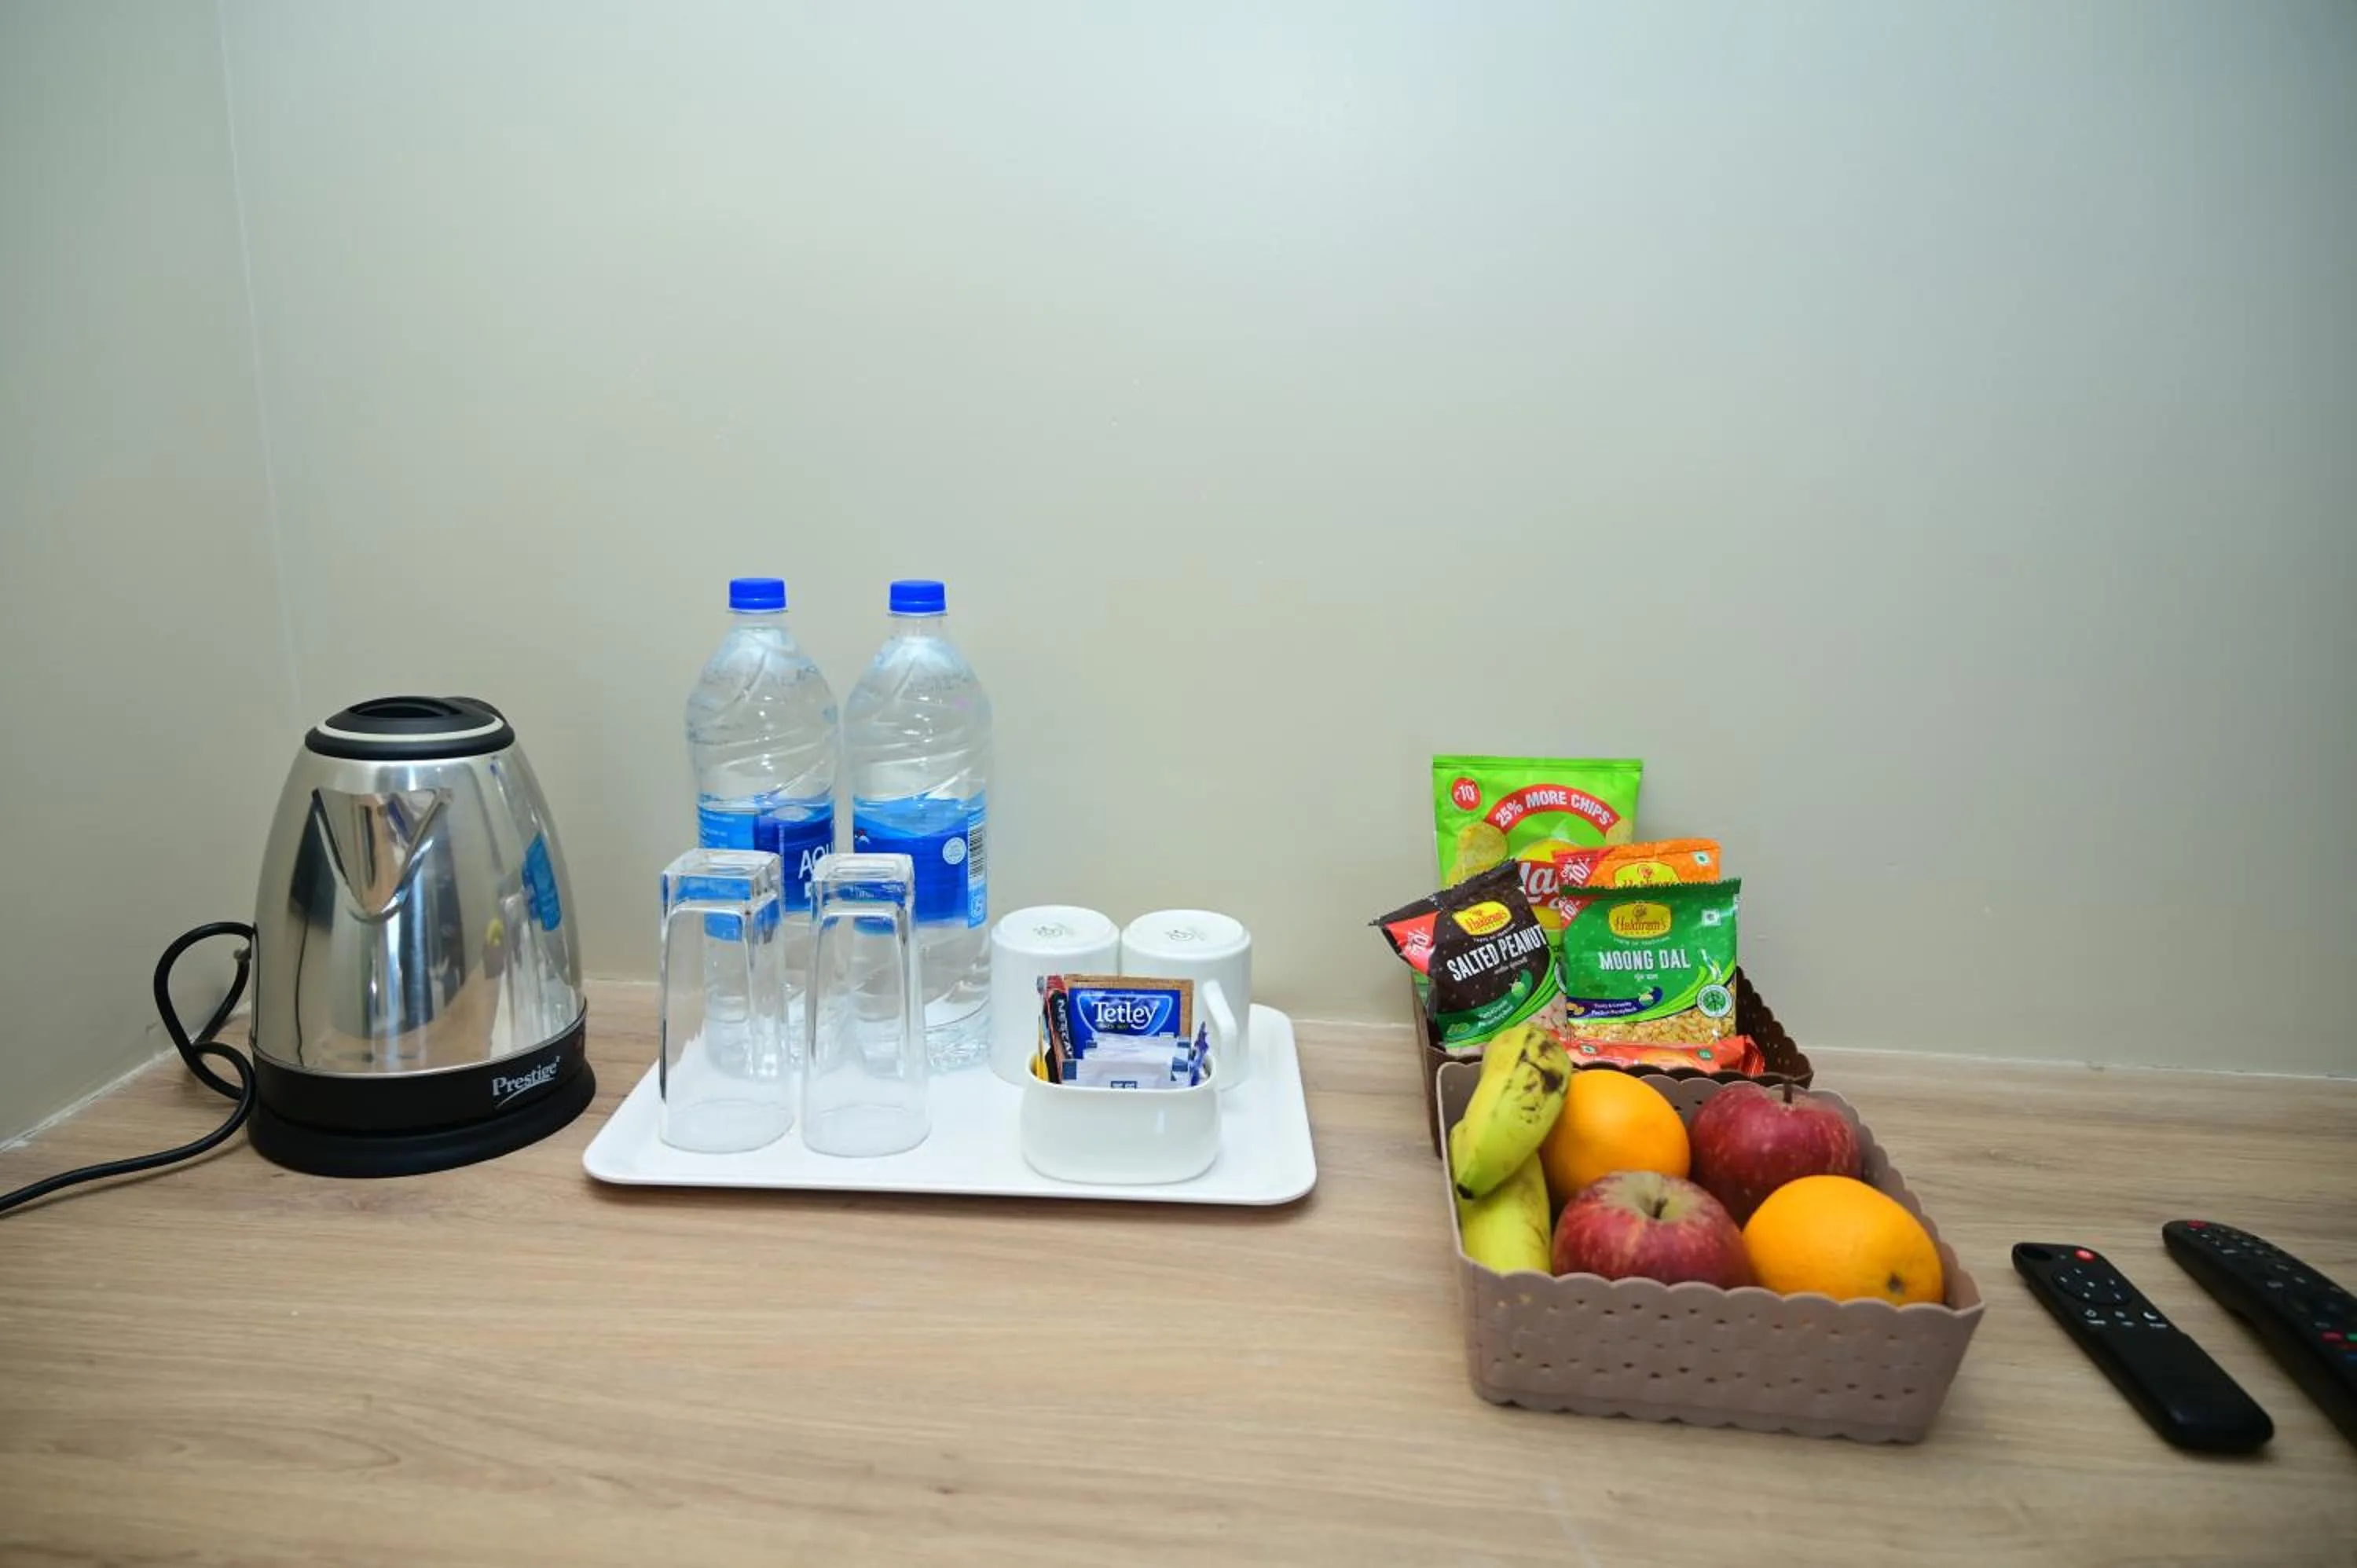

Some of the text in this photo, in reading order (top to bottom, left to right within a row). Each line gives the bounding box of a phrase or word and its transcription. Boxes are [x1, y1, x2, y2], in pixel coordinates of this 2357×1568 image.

[1495, 800, 1523, 826] 25%
[1525, 791, 1567, 808] MORE
[1616, 916, 1666, 932] Haldiram's
[1446, 943, 1500, 981] SALTED
[1499, 925, 1547, 962] PEANUT
[1598, 949, 1691, 971] MOONG DAL
[1091, 1000, 1160, 1030] Tetley
[492, 1063, 558, 1096] Prestige
